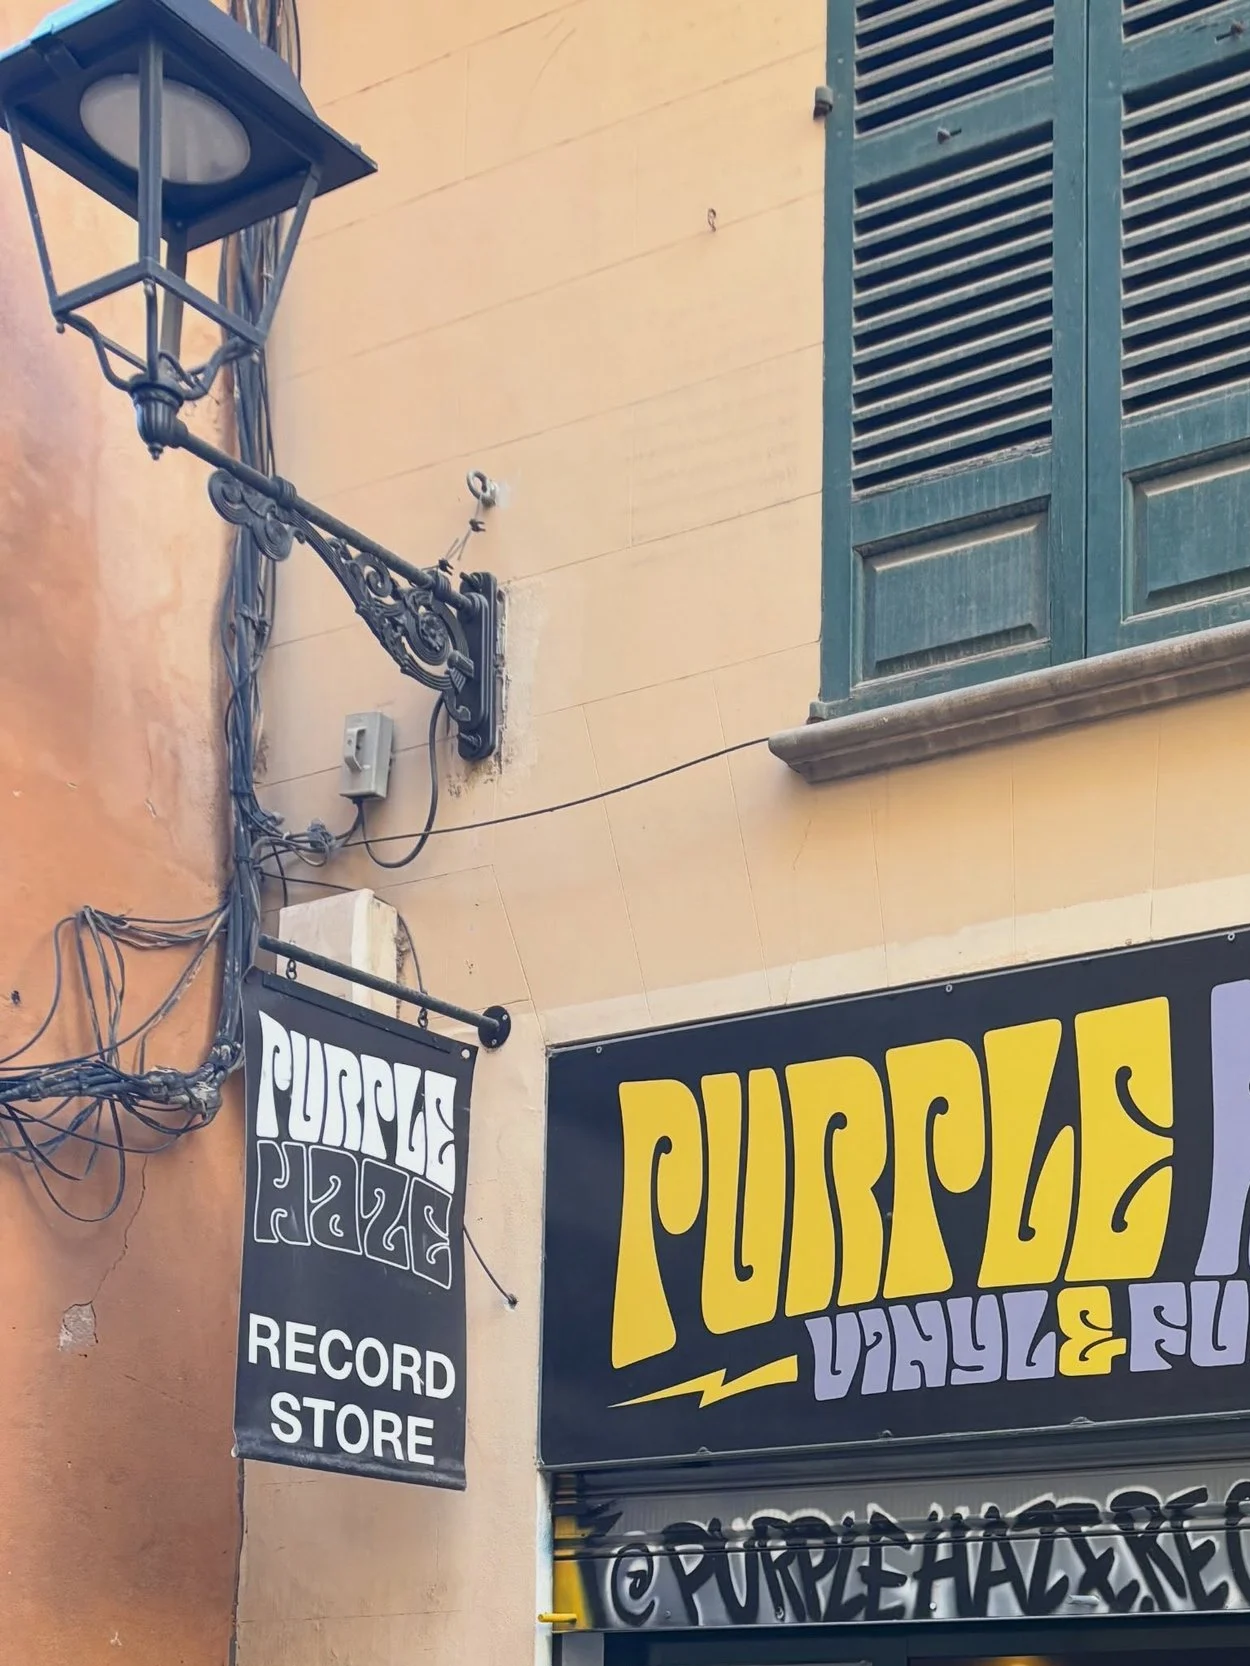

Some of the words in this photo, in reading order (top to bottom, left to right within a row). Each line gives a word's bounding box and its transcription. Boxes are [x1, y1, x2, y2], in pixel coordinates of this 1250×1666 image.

[255, 1010, 457, 1194] PURPLE
[253, 1140, 453, 1290] HAZE
[612, 996, 1174, 1369] PURPLE
[246, 1312, 457, 1401] RECORD
[270, 1391, 436, 1466] STORE
